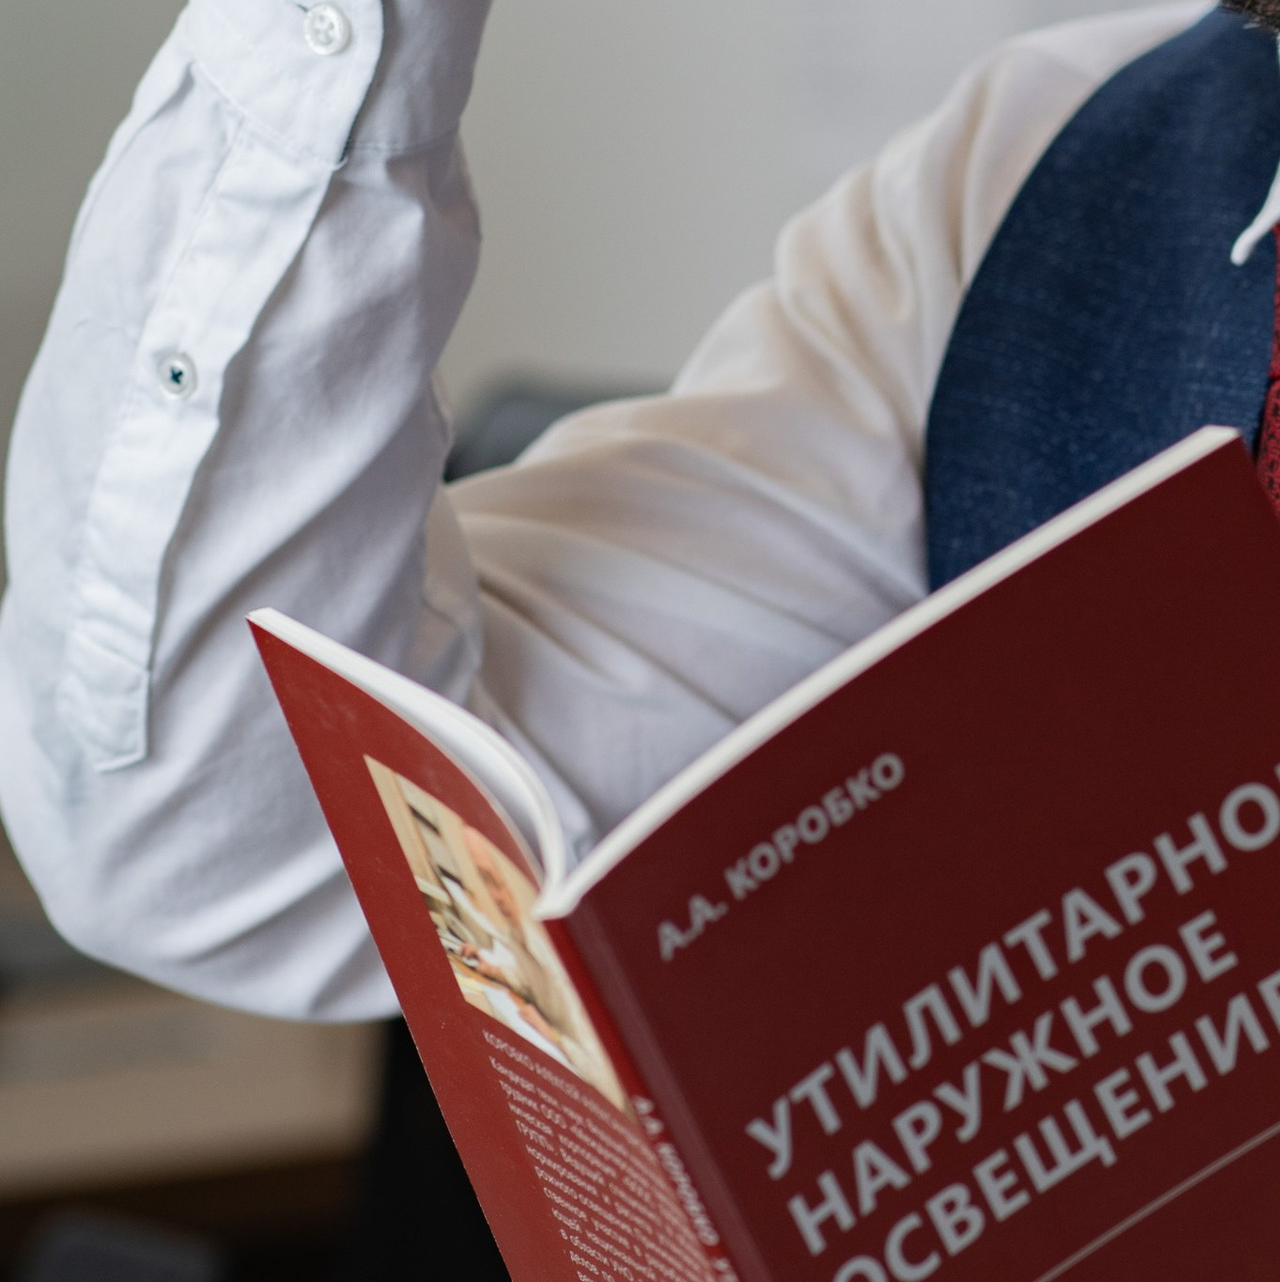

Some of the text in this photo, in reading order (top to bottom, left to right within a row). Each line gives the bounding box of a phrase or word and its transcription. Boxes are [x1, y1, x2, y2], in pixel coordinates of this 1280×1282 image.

[654, 751, 905, 961] А.А. КОРОБКО
[786, 910, 1239, 1256] НАРУЖНОЕ
